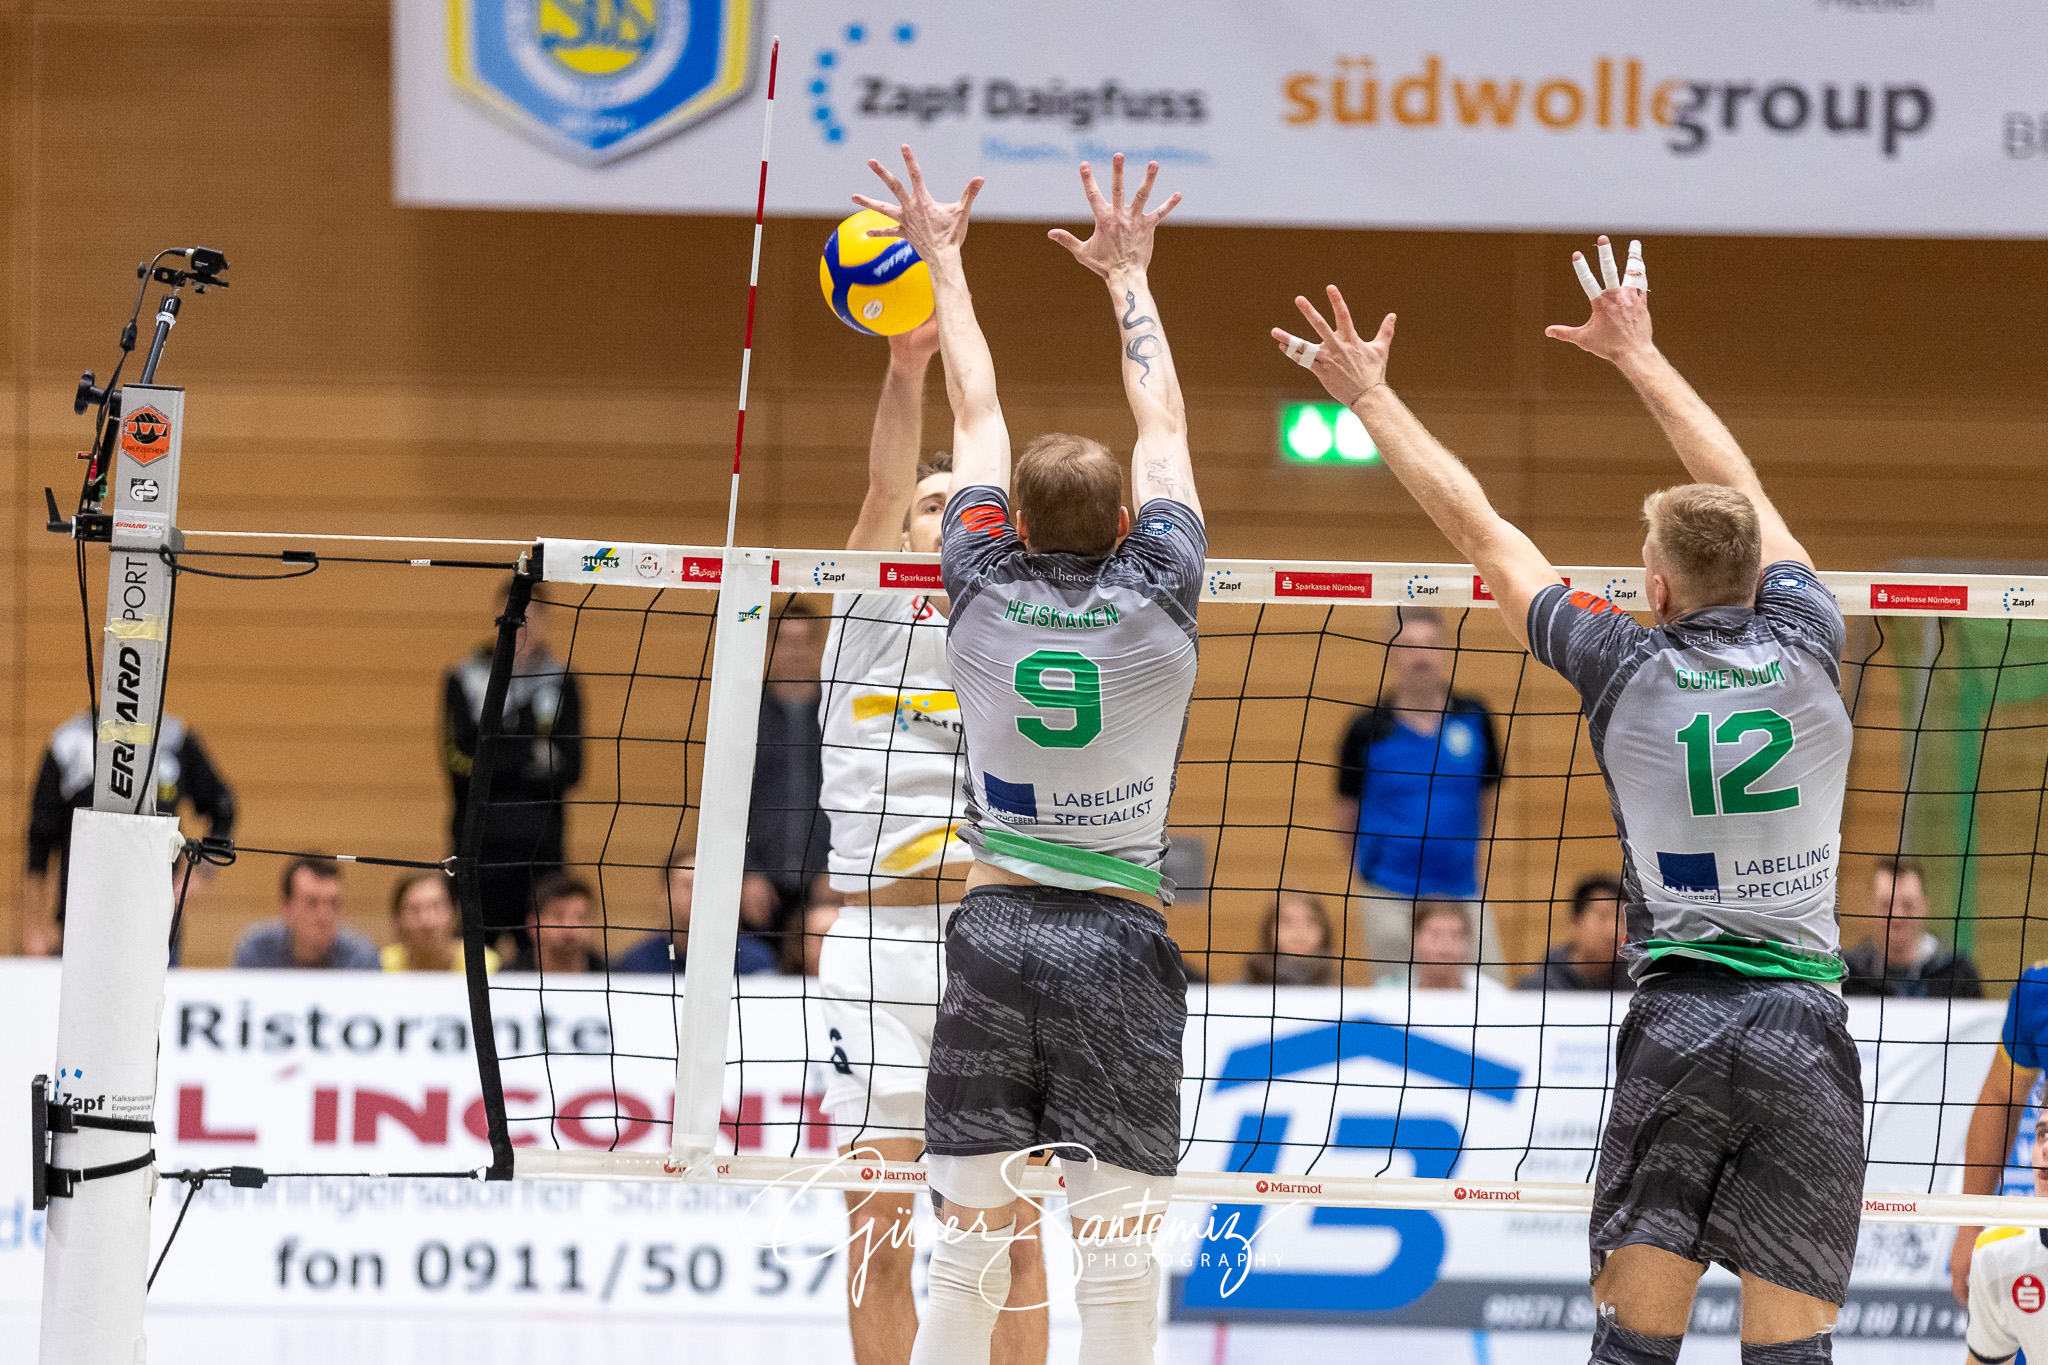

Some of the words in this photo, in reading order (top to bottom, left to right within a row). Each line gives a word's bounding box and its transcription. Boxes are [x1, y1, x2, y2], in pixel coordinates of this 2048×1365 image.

[857, 75, 969, 123] Zapf
[984, 76, 1205, 127] Daigfuss
[115, 521, 147, 529] ERHARD
[581, 556, 620, 569] HUCK
[822, 573, 845, 582] Zapf
[900, 573, 936, 583] Sparkasse
[122, 557, 148, 621] PORT
[1219, 581, 1241, 591] Zapf
[1295, 583, 1331, 592] Sparkasse
[1332, 584, 1365, 593] Nürnberg
[1416, 584, 1439, 596] Zapf
[1614, 588, 1637, 600] Zapf
[1890, 595, 1926, 604] Sparkasse
[1927, 595, 1961, 606] Nürnberg
[2012, 598, 2035, 608] Zapf
[1004, 598, 1120, 629] HEISKANEN
[1676, 660, 1786, 690] GUMENJUK
[1013, 649, 1103, 749] 9
[1675, 707, 1801, 817] 12
[1053, 776, 1154, 808] LABELLING
[1054, 800, 1153, 826] SPECIALIST
[1734, 844, 1830, 876] LABELLING
[1737, 867, 1830, 898] SPECIALIST
[177, 1000, 611, 1056] Ristorante
[63, 1092, 105, 1113] Zapf
[876, 1169, 927, 1181] Marmot
[1270, 1181, 1322, 1195] Marmot
[1469, 1188, 1520, 1201] Marmot
[1866, 1200, 1917, 1212] Marmot
[276, 1238, 386, 1289] fon
[416, 1243, 724, 1303] 0911/50
